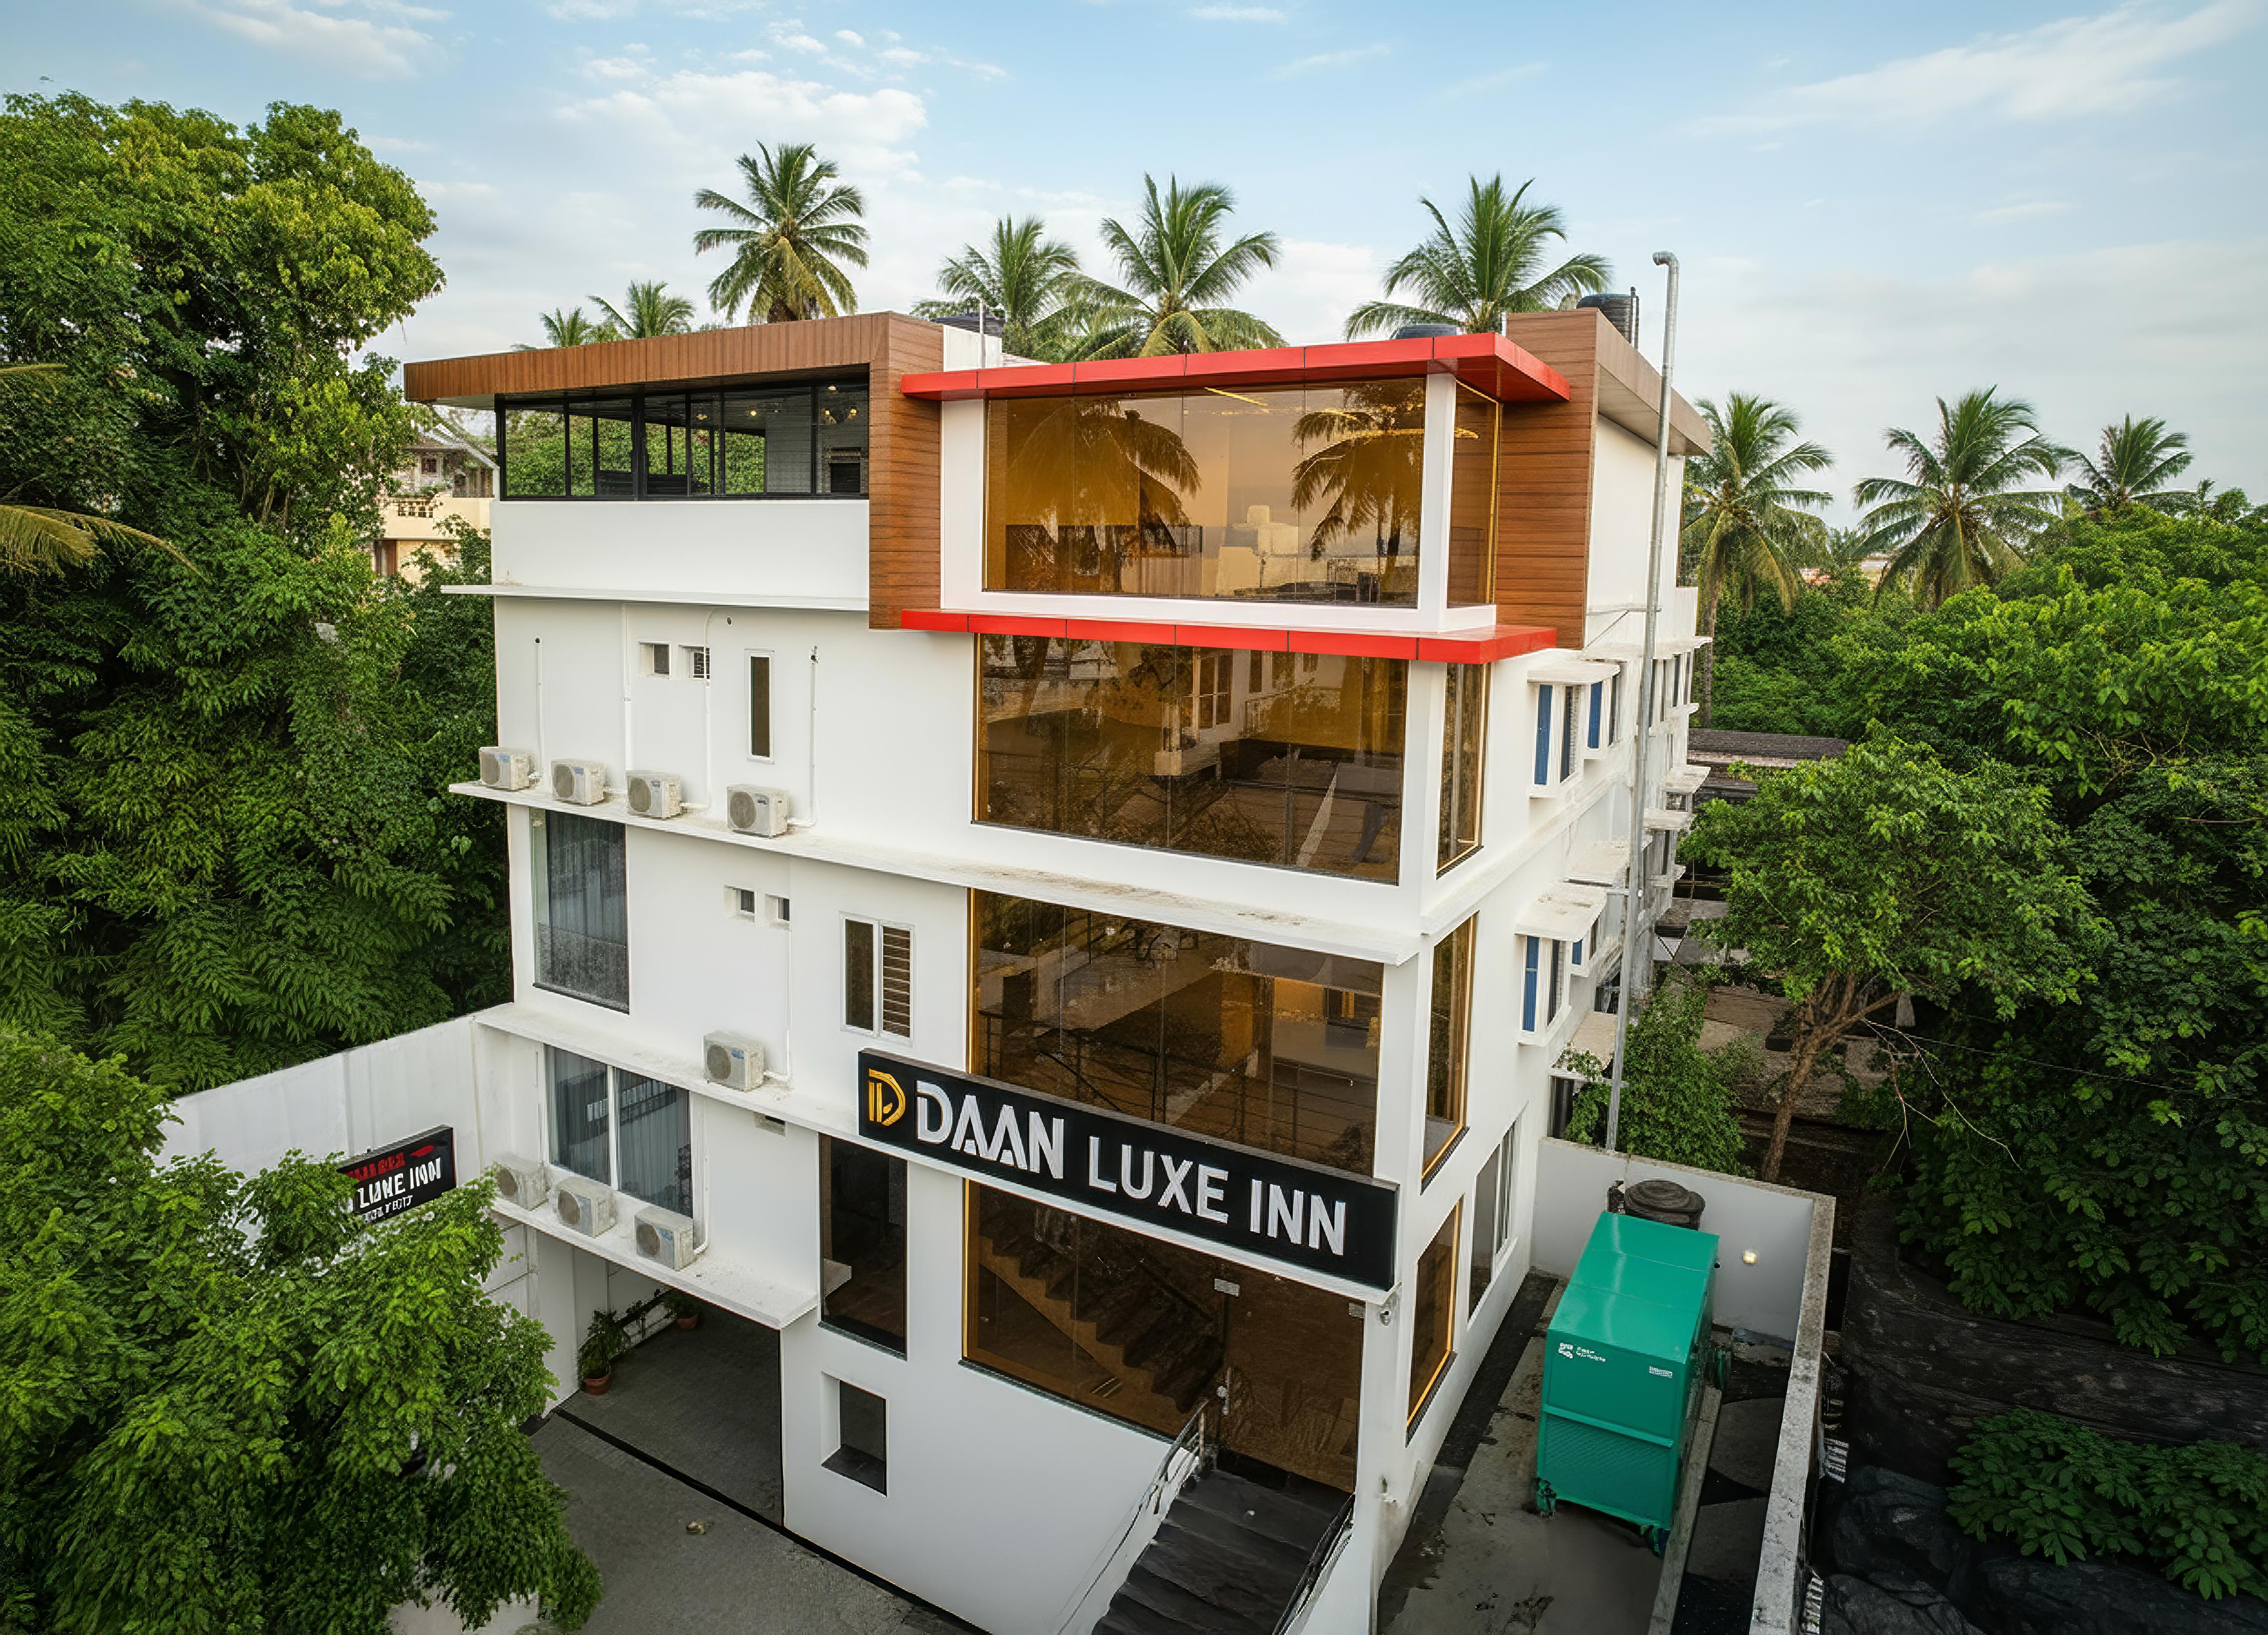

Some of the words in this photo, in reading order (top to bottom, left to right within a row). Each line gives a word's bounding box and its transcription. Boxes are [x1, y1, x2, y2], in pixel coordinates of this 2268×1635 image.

[916, 1080, 1064, 1180] DAAN
[1088, 1135, 1229, 1224] LUXE
[1249, 1178, 1347, 1256] INN
